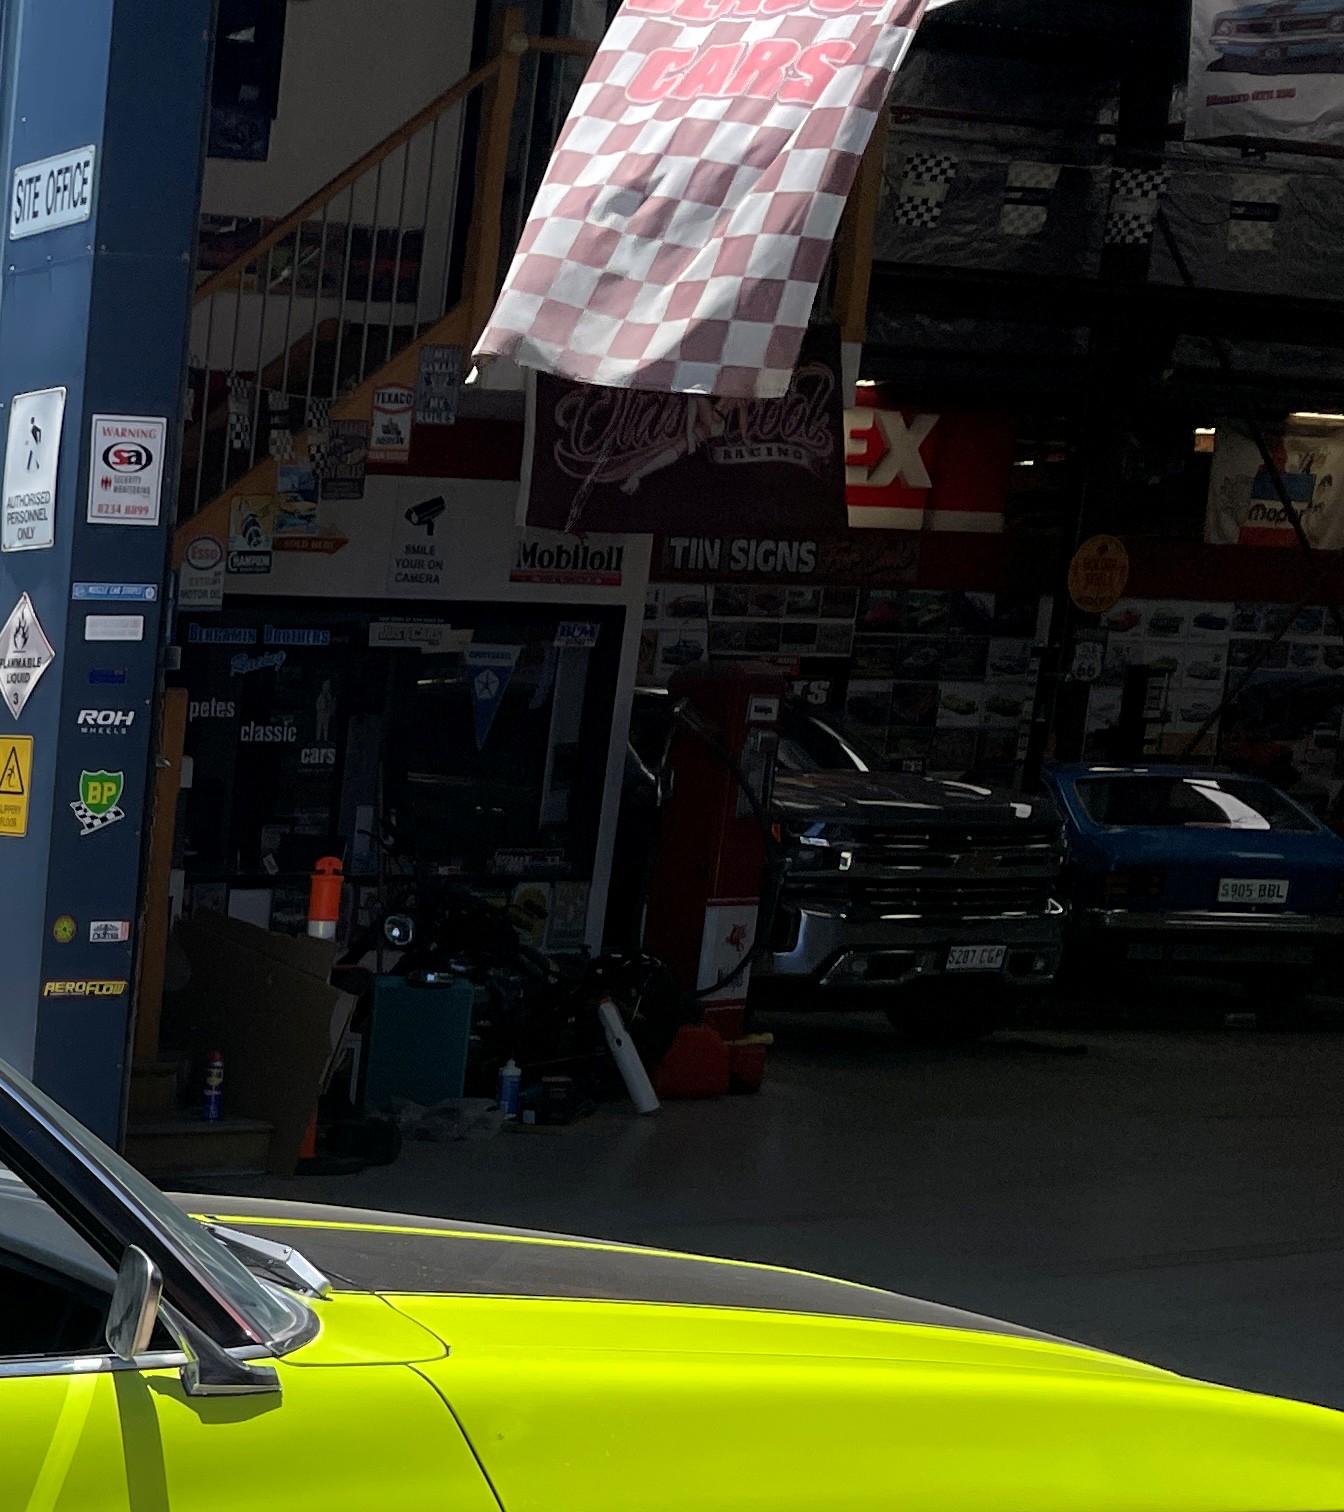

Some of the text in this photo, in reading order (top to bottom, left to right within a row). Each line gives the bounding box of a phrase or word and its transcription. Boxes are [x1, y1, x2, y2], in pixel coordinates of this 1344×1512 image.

[624, 37, 857, 105] CARS
[14, 160, 90, 225] SITE OFFICE
[375, 391, 413, 405] TEXACO
[102, 425, 157, 440] WARNING
[6, 491, 52, 509] AUTHORISED
[7, 508, 48, 526] PERSONNEL
[17, 526, 36, 541] ONLY
[190, 544, 218, 560] Esso
[404, 545, 436, 556] SMILE
[517, 540, 625, 571] Mobiloil
[669, 536, 817, 573] TIN SIGNS
[395, 558, 444, 571] YOUR ON
[394, 572, 441, 584] CAMERA
[0, 657, 42, 669] FLAMMABLE
[6, 673, 31, 684] LIQUID
[13, 693, 19, 705] 3
[77, 709, 136, 726] ROH
[189, 698, 236, 723] petes
[81, 727, 127, 736] WHEELS
[240, 720, 297, 743] classic
[300, 747, 336, 764] cars
[86, 781, 118, 805] BP
[43, 980, 129, 998] AEROFLOW
